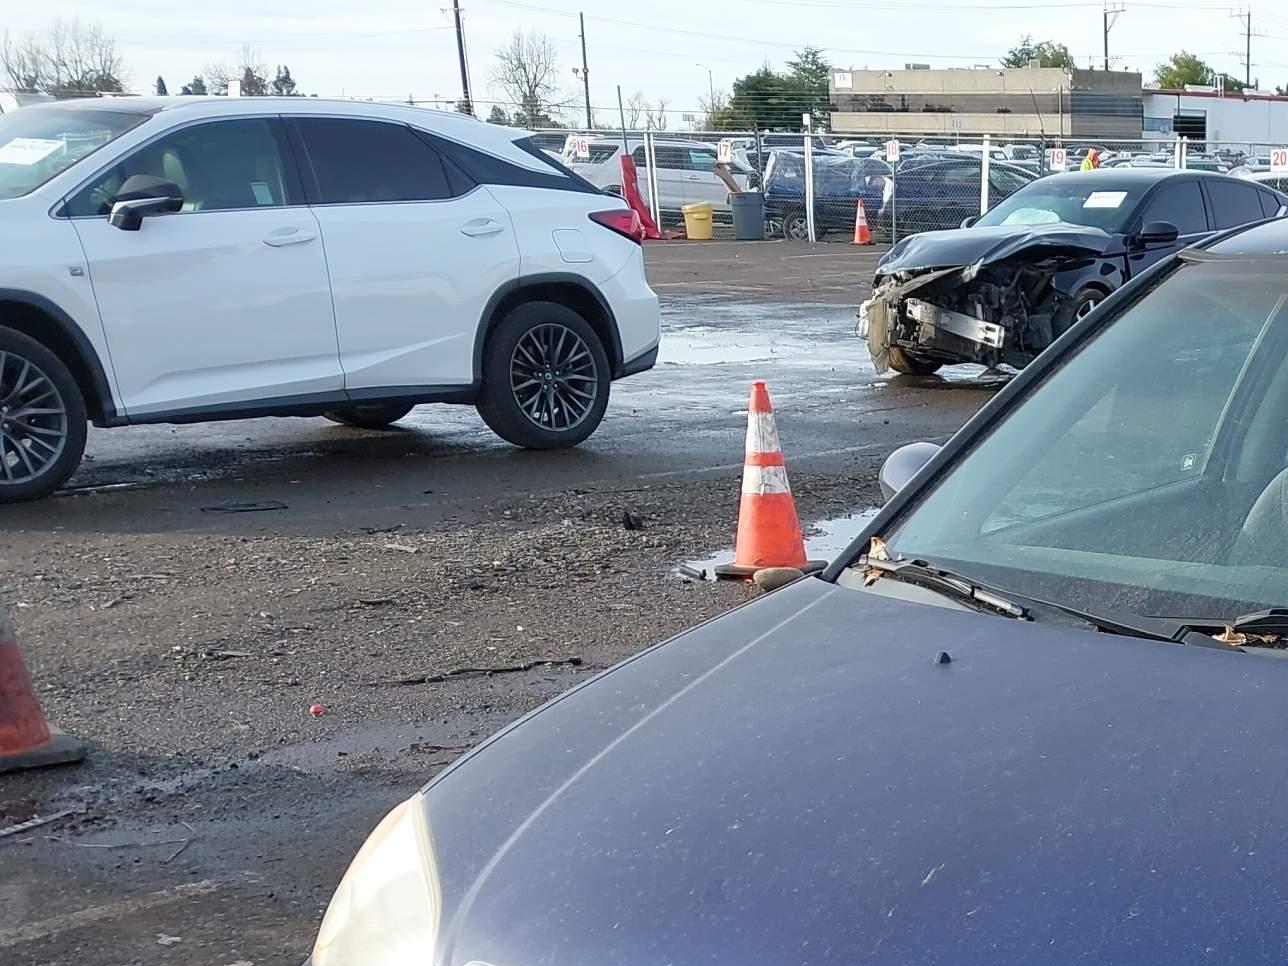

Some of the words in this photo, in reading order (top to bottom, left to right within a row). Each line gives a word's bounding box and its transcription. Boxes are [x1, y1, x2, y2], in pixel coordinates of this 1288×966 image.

[576, 139, 588, 153] 16
[719, 143, 729, 157] 17
[1051, 150, 1064, 165] 19
[1272, 150, 1287, 167] 20
